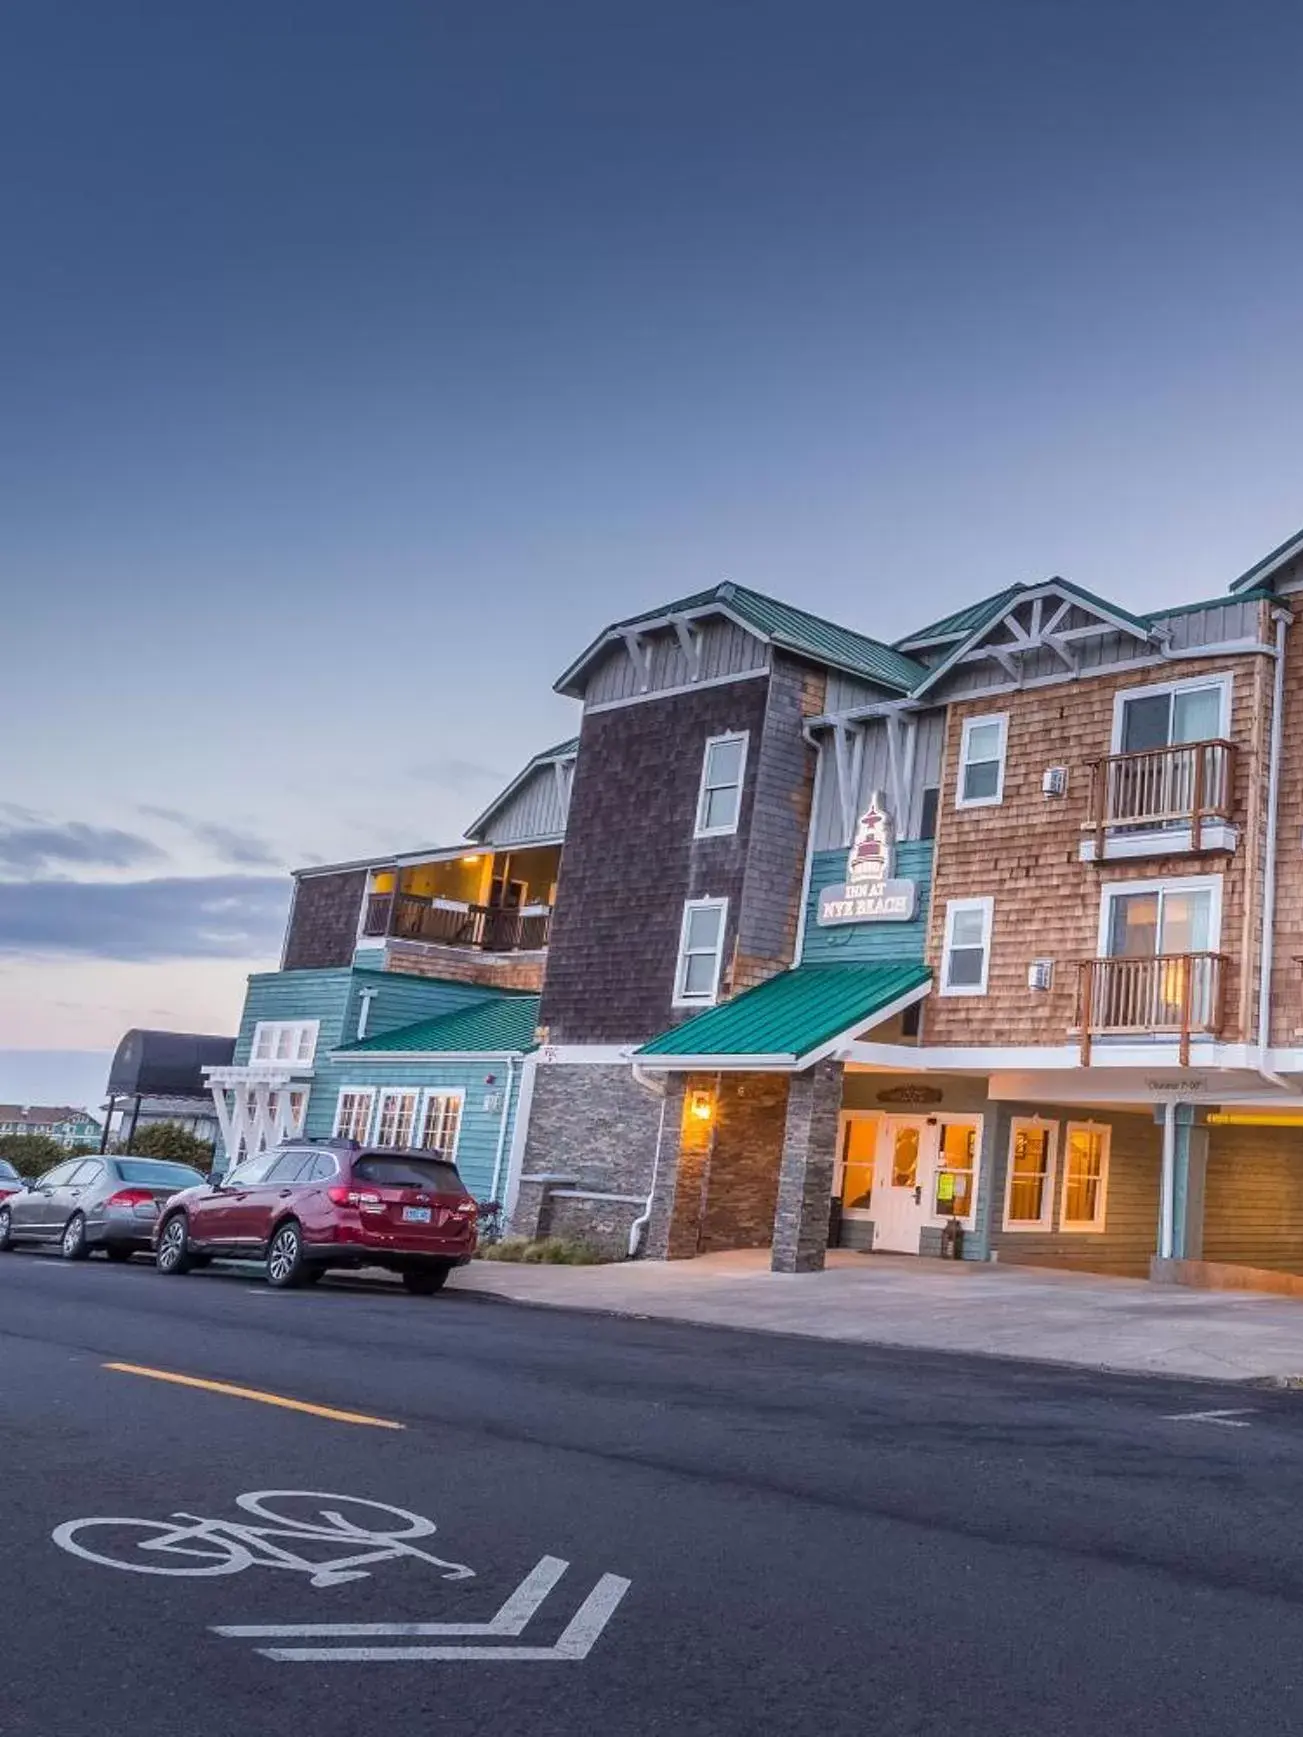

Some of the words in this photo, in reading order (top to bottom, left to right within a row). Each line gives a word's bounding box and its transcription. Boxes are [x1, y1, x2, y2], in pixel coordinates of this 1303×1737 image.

[845, 884, 868, 899] INN
[868, 882, 887, 897] AT
[823, 901, 853, 918] NYE
[855, 896, 908, 916] BEACH
